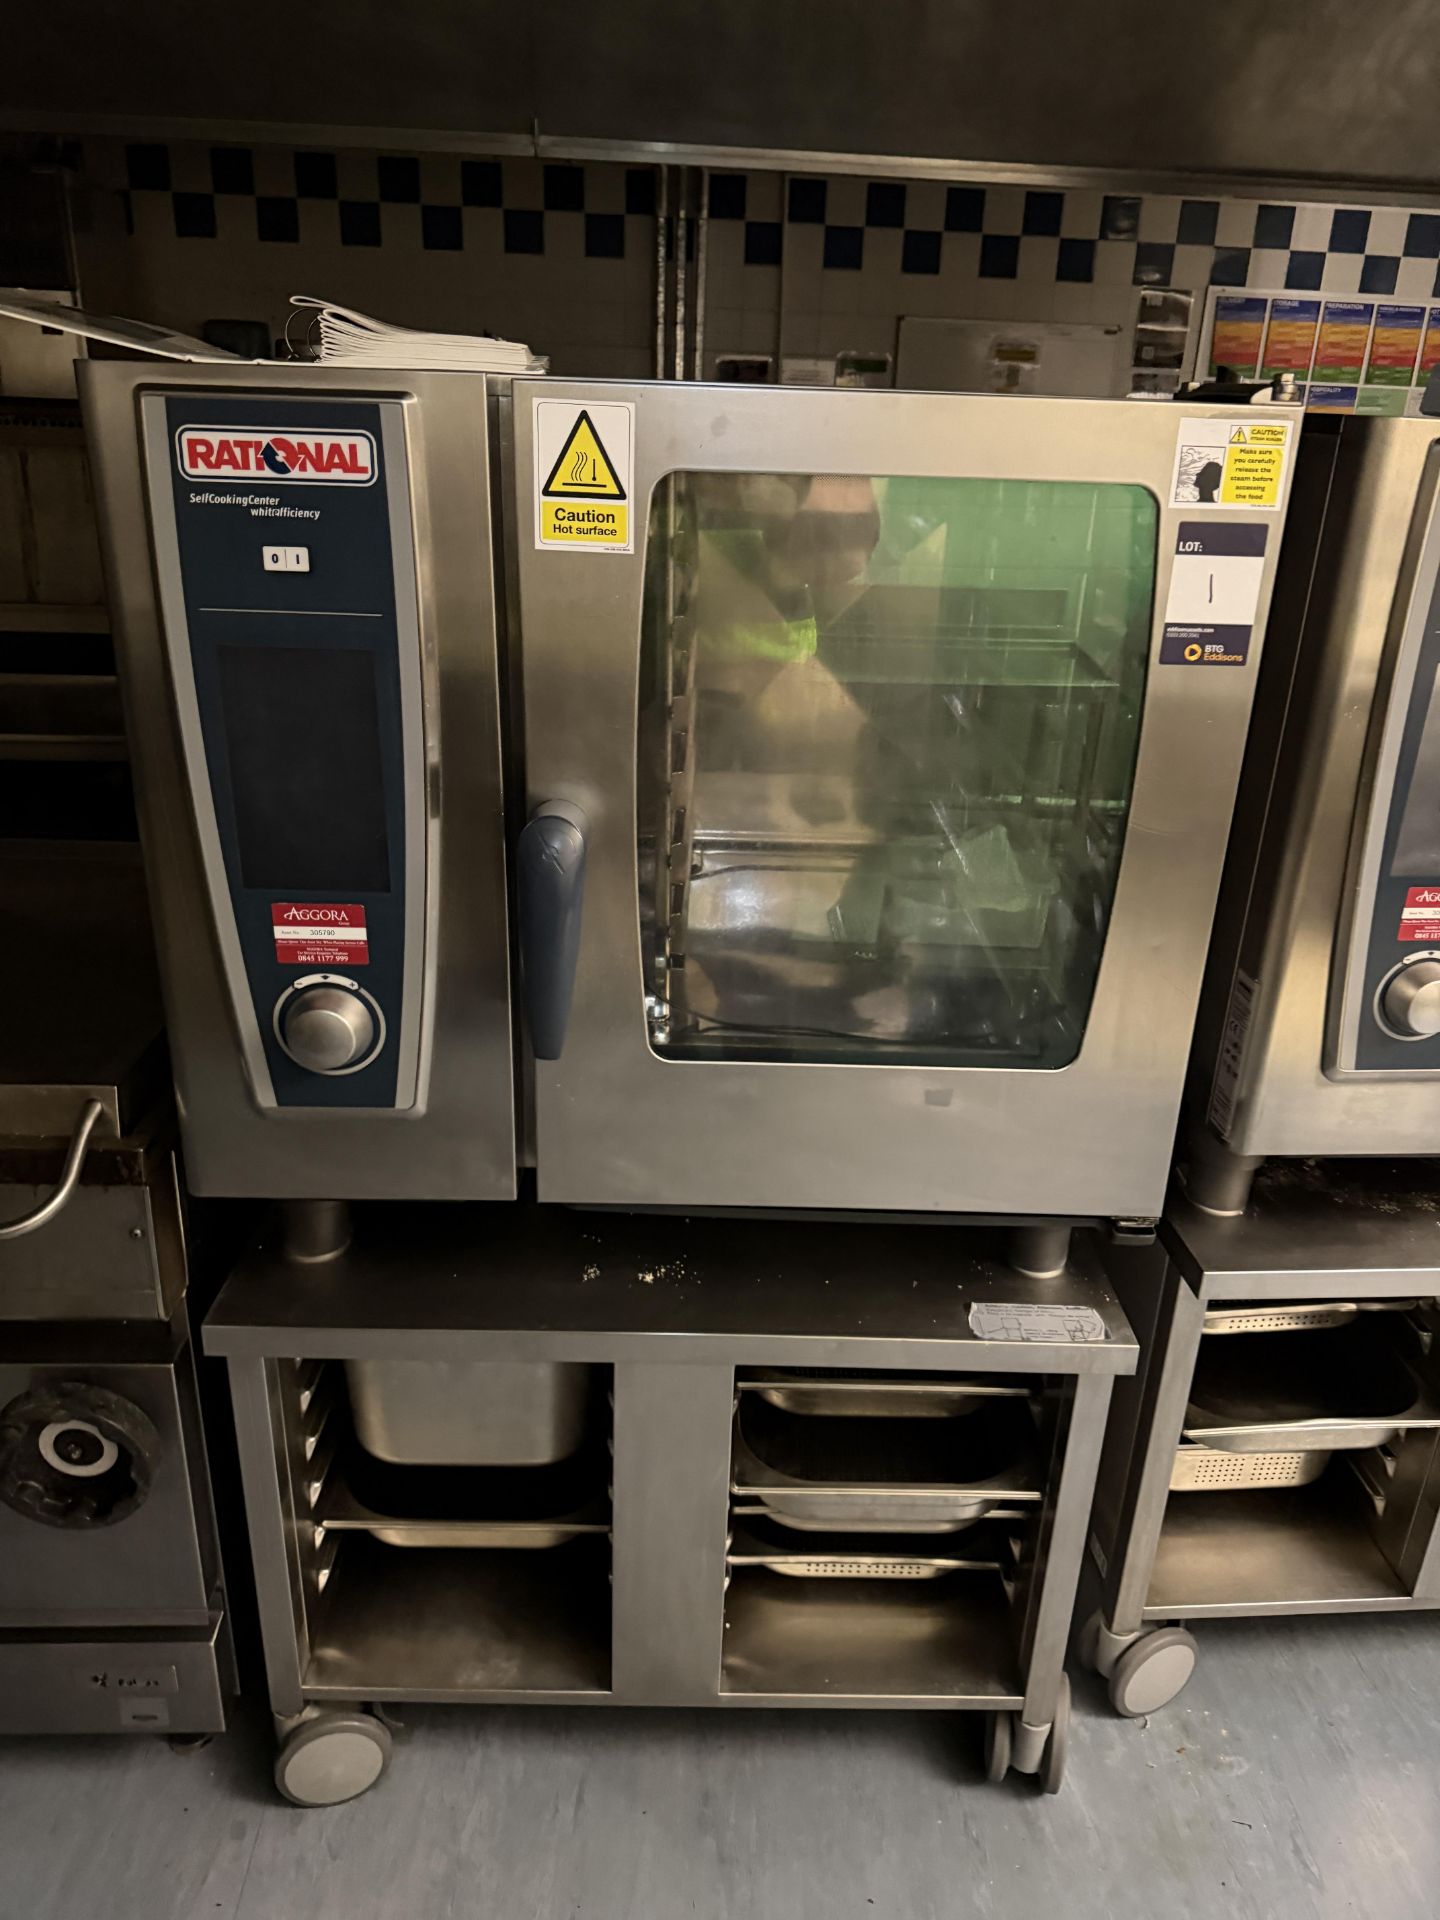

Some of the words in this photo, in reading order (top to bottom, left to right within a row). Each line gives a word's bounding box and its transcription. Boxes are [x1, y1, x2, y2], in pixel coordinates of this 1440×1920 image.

[186, 437, 369, 474] RATIONAL
[189, 492, 280, 507] SelfCookingCenter
[554, 507, 616, 524] Caution
[552, 523, 573, 535] Hot
[575, 525, 618, 537] surface
[1178, 541, 1203, 552] LOT:
[1204, 644, 1225, 653] BTG
[1203, 653, 1244, 662] Eddisons
[283, 906, 349, 921] AGGORA
[297, 954, 315, 962] 0845
